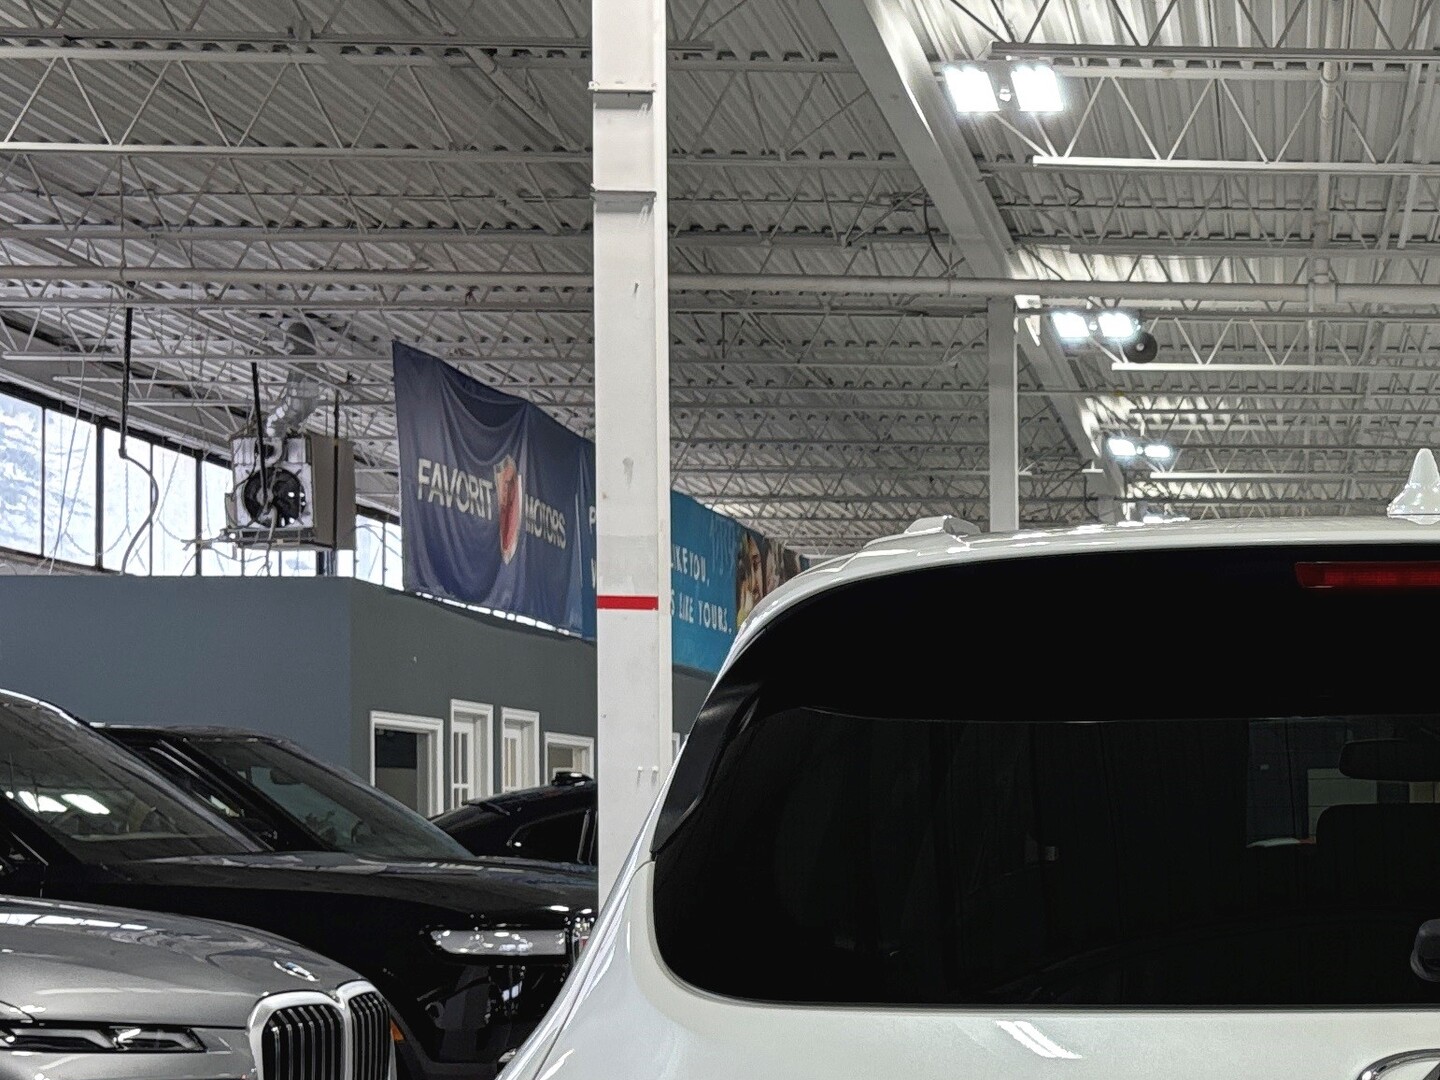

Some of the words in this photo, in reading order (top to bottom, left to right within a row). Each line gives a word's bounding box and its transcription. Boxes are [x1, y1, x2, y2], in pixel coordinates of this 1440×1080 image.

[418, 458, 494, 520] FAVORIT
[525, 494, 566, 549] MOTORS
[698, 600, 732, 634] YOURS.
